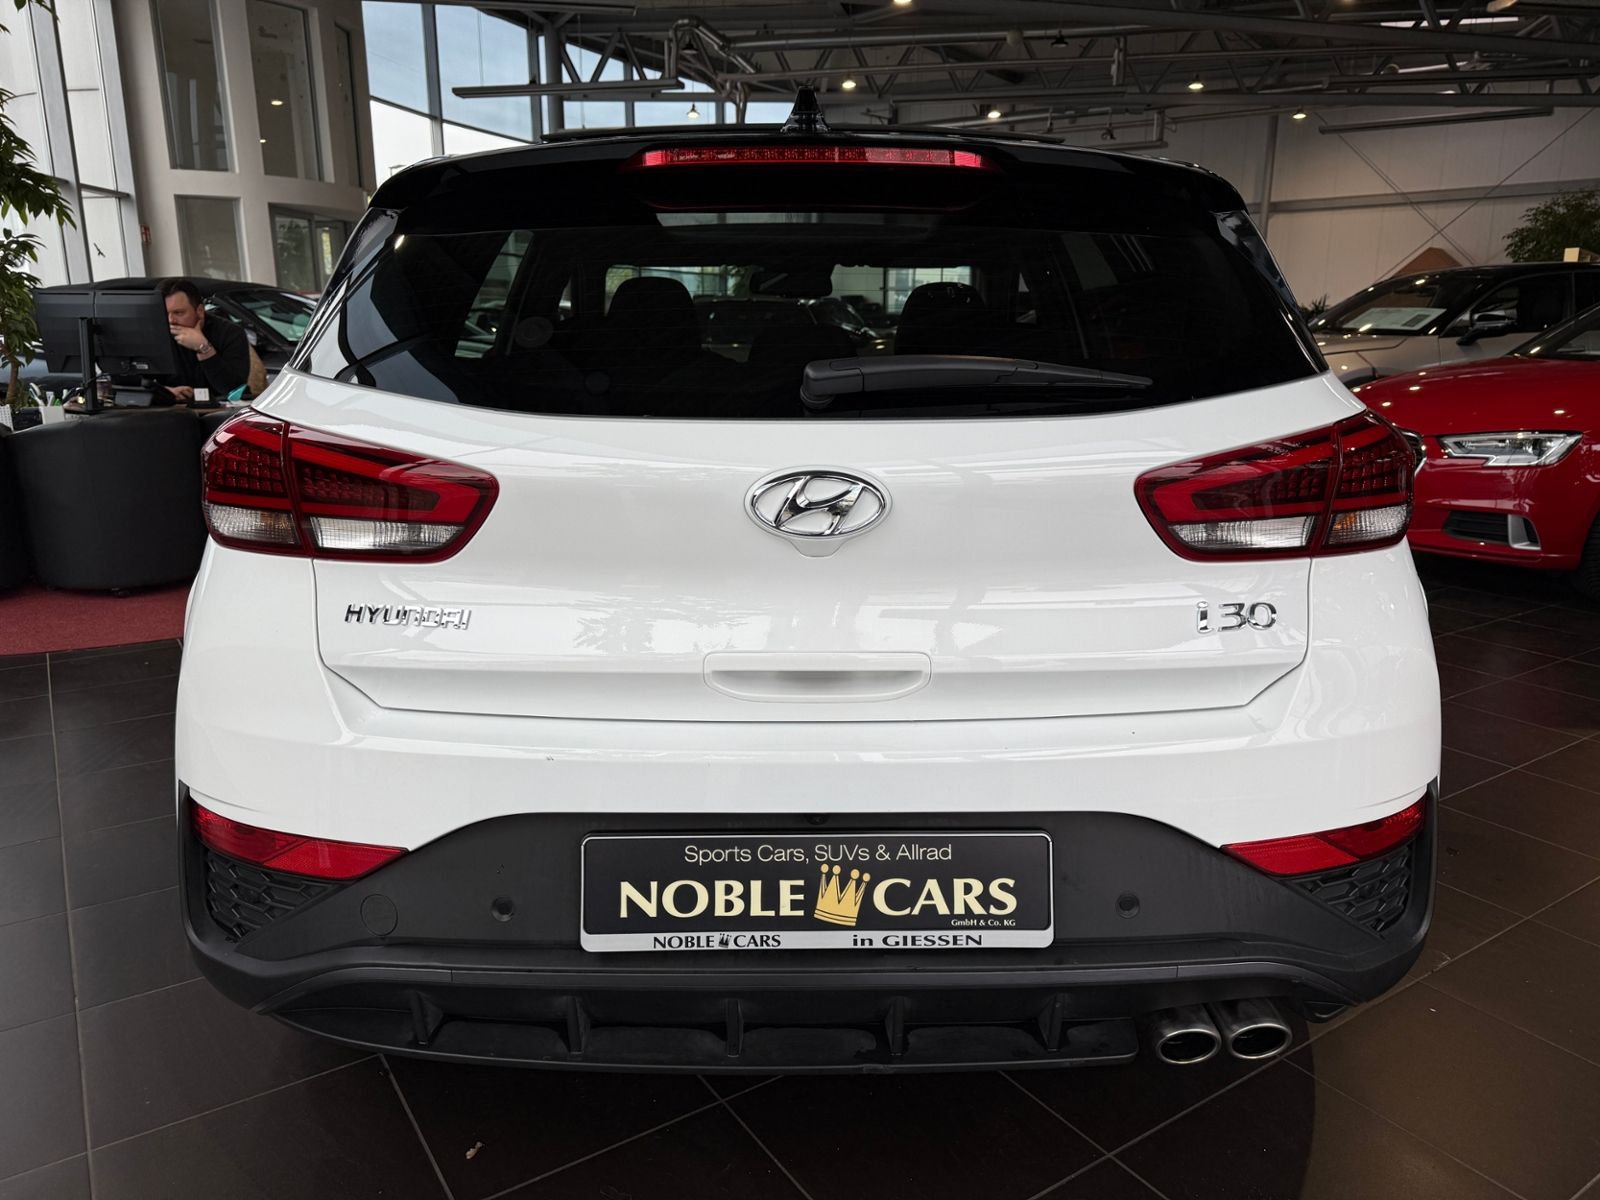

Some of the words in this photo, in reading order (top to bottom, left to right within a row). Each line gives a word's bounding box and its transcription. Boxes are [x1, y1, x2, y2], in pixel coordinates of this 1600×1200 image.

[344, 604, 472, 630] HYUNDAI
[684, 845, 752, 865] Sports
[756, 845, 809, 864] Cars,
[814, 845, 870, 862] SUVs
[875, 845, 891, 861] &
[896, 844, 952, 861] Allrad
[619, 879, 805, 919] NOBLE
[872, 877, 1018, 917] CARS
[653, 936, 715, 949] NOBLE
[733, 934, 781, 948] CARS
[852, 934, 873, 947] in
[881, 934, 983, 947] GIESSEN
